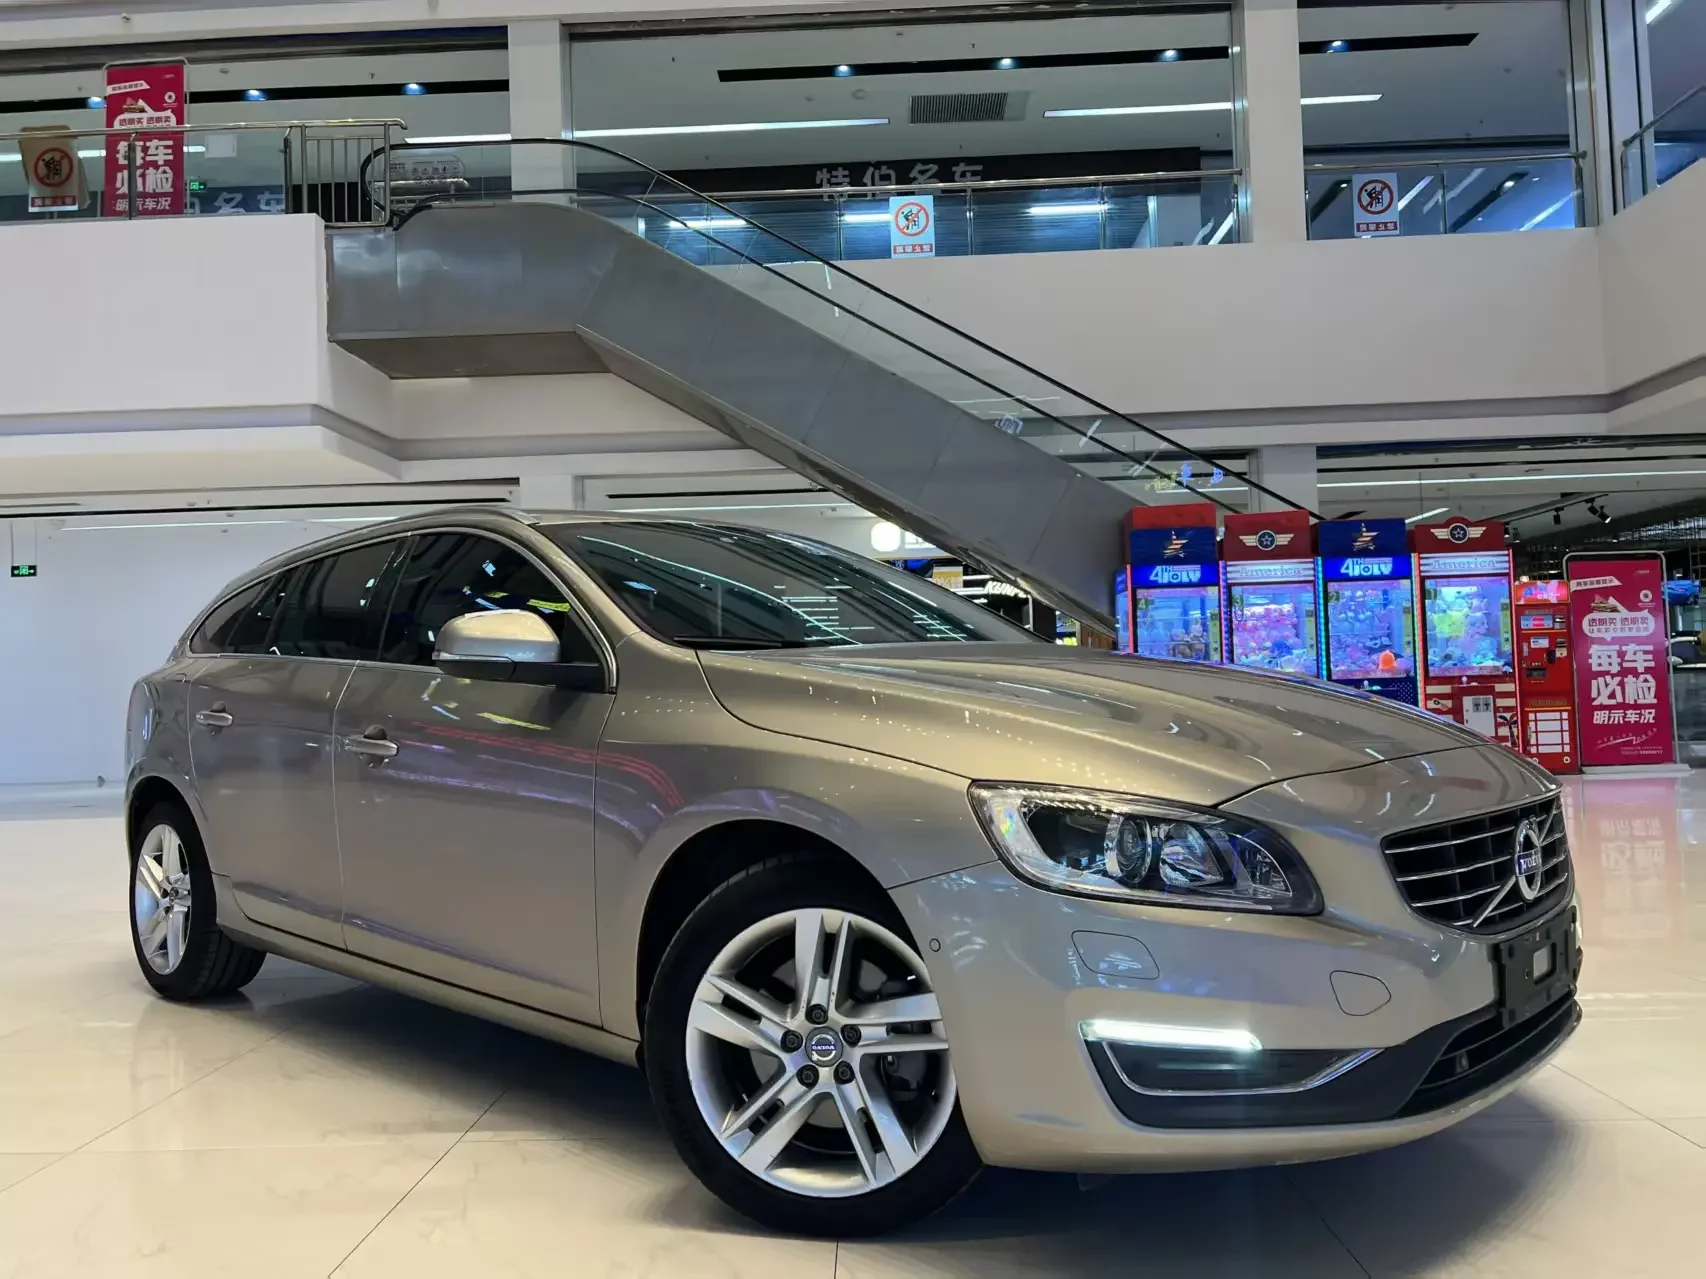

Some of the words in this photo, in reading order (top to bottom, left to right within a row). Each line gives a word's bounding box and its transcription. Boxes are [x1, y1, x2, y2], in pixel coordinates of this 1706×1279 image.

[1432, 558, 1497, 569] America
[1588, 643, 1655, 673] 每车
[1591, 675, 1658, 706] 必检
[1592, 708, 1656, 725] 明示车况
